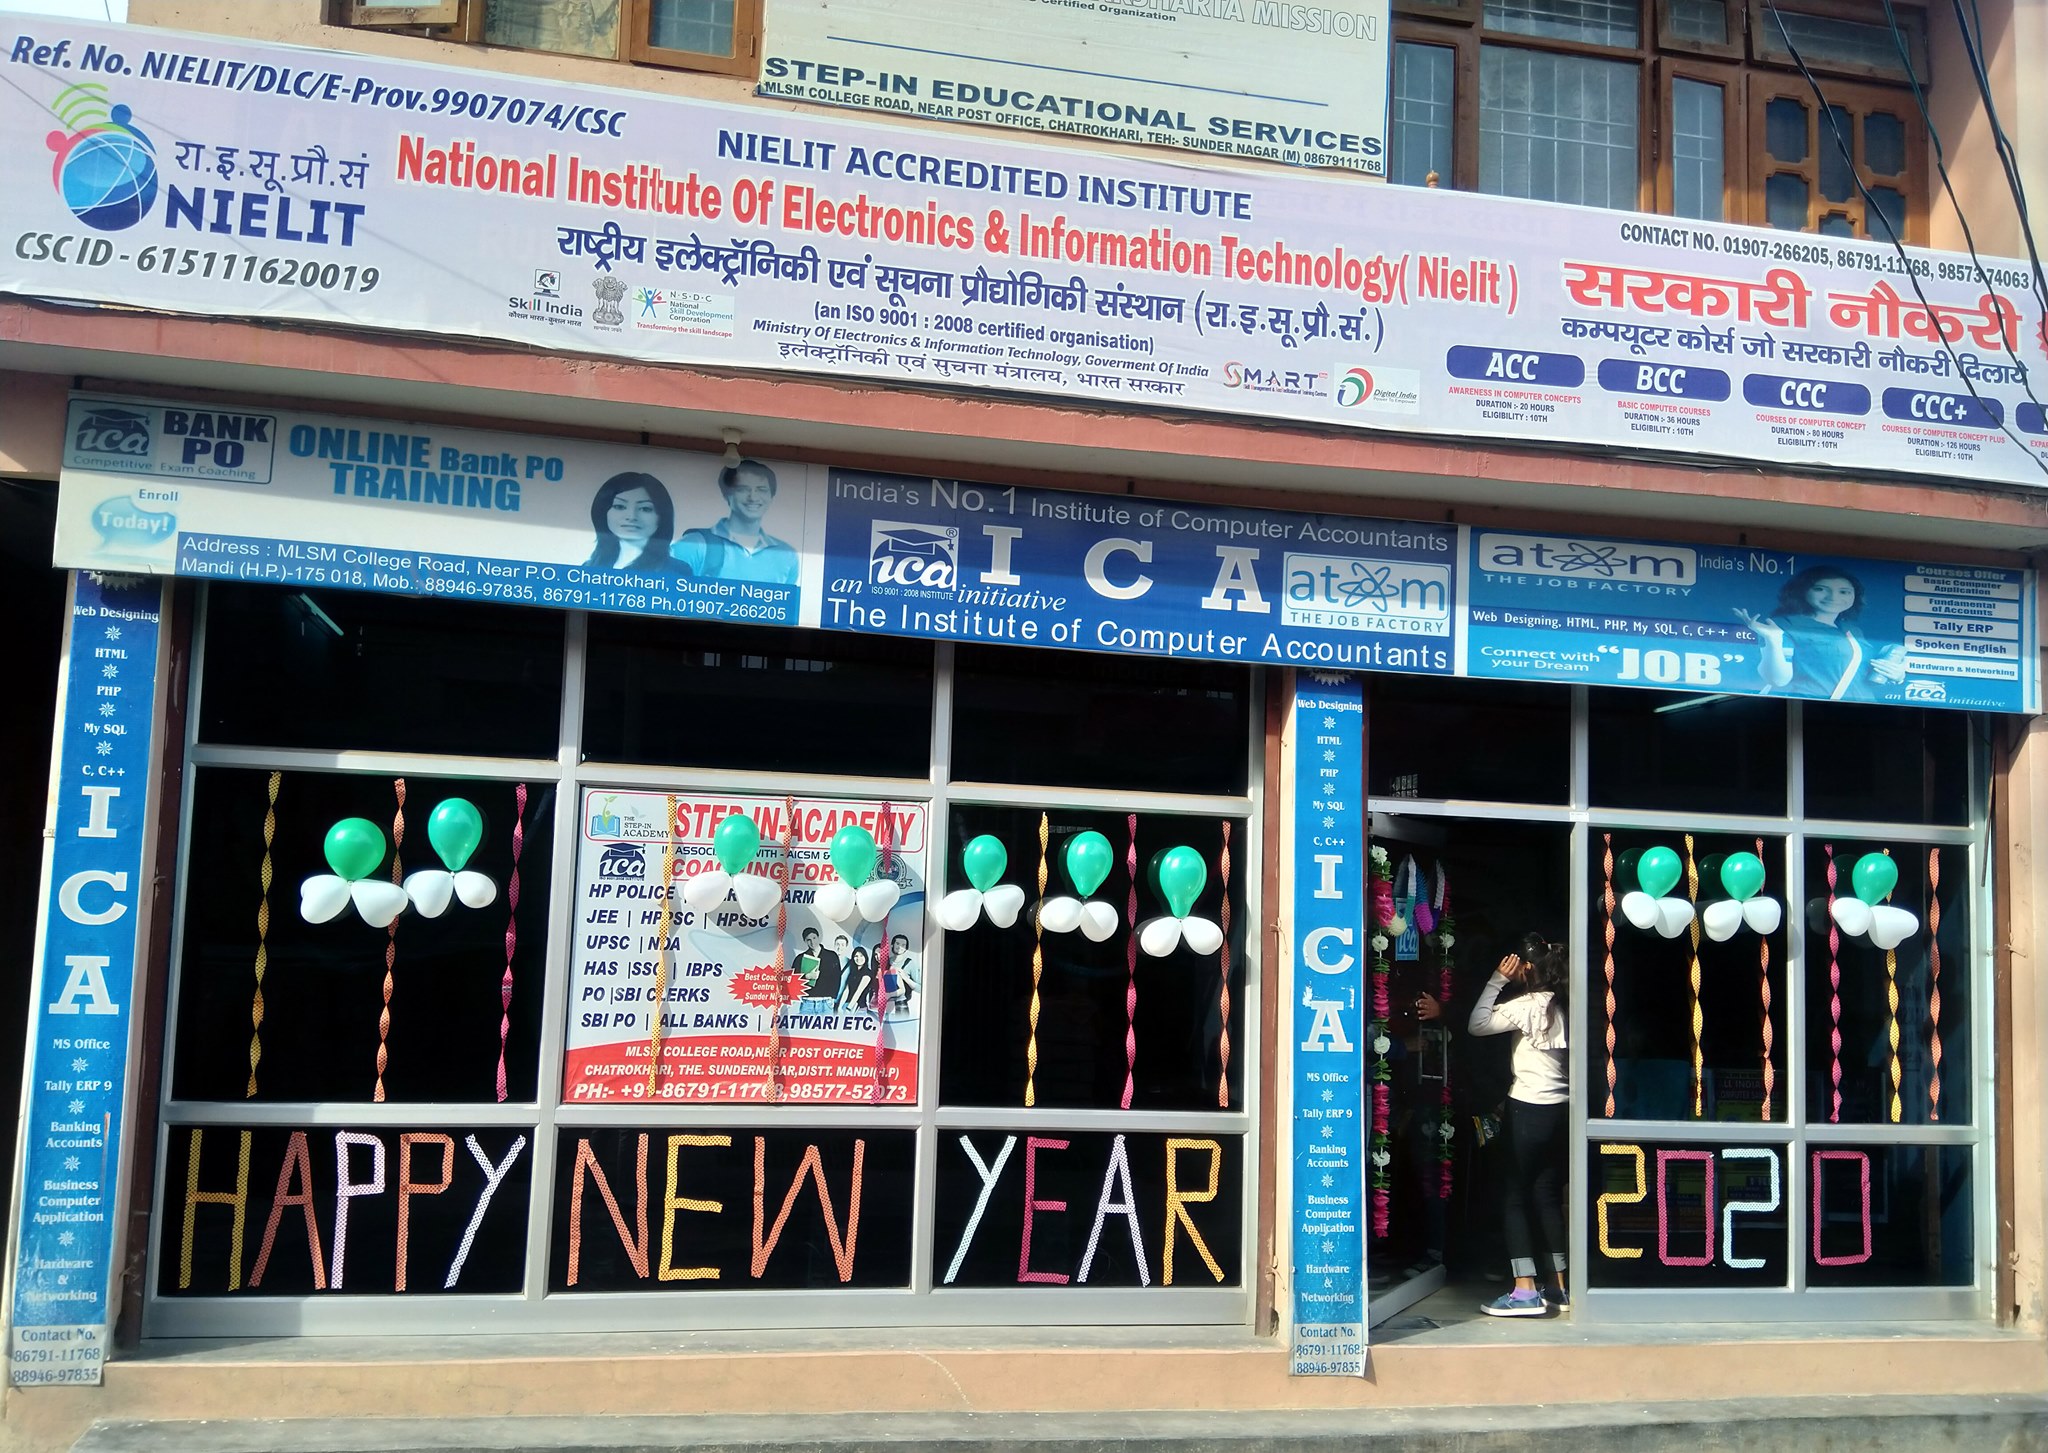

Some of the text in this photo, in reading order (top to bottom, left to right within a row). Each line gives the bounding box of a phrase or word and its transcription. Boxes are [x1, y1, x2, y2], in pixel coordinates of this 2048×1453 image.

[1252, 1, 1377, 41] MISSION
[10, 36, 627, 138] Ref. No. NIELIT/DLC/E-Prov.9907074/CSC
[765, 57, 1382, 156] STEP-IN EDUCATIONAL SERVICES
[765, 81, 1382, 172] MLSM COLLEGE ROAD, NEAR POST OFFICE, CHATROKHARI, TEH:- SUNDER NAGAR (M) 08679111768
[718, 130, 1252, 220] NIELIT ACCREDITED INSTITUTE
[165, 184, 366, 247] NIELIT
[397, 135, 557, 198] National
[568, 156, 722, 220] Institute
[733, 179, 774, 226] Of
[783, 185, 974, 250] Electronics
[984, 210, 1010, 254] &
[1020, 213, 1212, 276] Information
[1418, 256, 1500, 304] Nielit
[1621, 223, 1689, 248] CONTACT
[1693, 232, 1720, 252] NO.
[1724, 236, 1833, 269] 01907-266205,
[15, 232, 380, 293] CSC ID 615111620019
[557, 221, 647, 272] राष्ट्रीय
[656, 233, 820, 287] इलेक्ट्रॉनिकी
[828, 254, 873, 289] एवं
[875, 265, 953, 307] सूचना
[961, 266, 1088, 313] प्रौद्योगिकी
[1095, 282, 1185, 323] संस्थान
[509, 296, 583, 317] Skill India
[1564, 262, 2022, 353] सरकारी नौकरी
[814, 301, 1155, 356] (an ISO 9001 2008 certified organisation)
[753, 319, 1209, 378] Ministry Of Electronics & Information Technology, Goverment Of India
[1561, 318, 1671, 355] कम्पयूटर
[1677, 325, 1734, 354] कोर्स
[1742, 332, 1776, 358] जो
[1782, 340, 1873, 369] सरकारी
[1878, 345, 1951, 378] नौकरी
[1485, 352, 1539, 381] ACC
[1636, 365, 1686, 394] BCC
[1449, 386, 1582, 404] AWARENESS COMPUTER CONCEPTS
[1780, 381, 1827, 408] CCC
[1910, 393, 1968, 421] CCC+
[163, 410, 271, 443] BANK
[182, 438, 244, 468] PO
[289, 424, 564, 482] ONLINE Bank PO
[329, 462, 521, 512] TRAINING
[1031, 498, 1130, 526] Institute
[1139, 508, 1164, 528] of
[1171, 510, 1293, 539] Computer
[1298, 522, 1448, 551] Accountants
[183, 537, 791, 603] Address MLSM College Road, Near P.O. Chatrokhari, Sunder Nagar
[182, 557, 234, 575] Mandi
[239, 562, 325, 583] (H.P.)-175
[330, 570, 366, 587] 018,
[425, 577, 537, 602] 88946-97835,
[543, 587, 646, 609] 86791-11768
[651, 596, 786, 622] Ph.01907-266205
[73, 605, 160, 623] Web Designing
[1933, 620, 1994, 634] Tally ERP
[827, 597, 1447, 669] The Institute of Computer Accountants
[1915, 638, 2007, 655] Spoken English
[95, 648, 128, 660] HTML
[1480, 645, 1600, 663] Connect with
[1492, 657, 1589, 672] your Dream
[97, 685, 122, 697] PHP
[1317, 735, 1342, 746] HTML
[1320, 768, 1339, 777] PHP
[589, 884, 612, 899] HP
[586, 910, 619, 924] JEE
[716, 913, 770, 928] HPSSC
[586, 936, 630, 950] UPSC
[584, 962, 618, 976] HAS
[685, 963, 723, 978] IBPS
[692, 1014, 748, 1029] BANKS
[842, 1017, 877, 1032] ETC.
[74, 1038, 110, 1050] Office
[663, 1047, 864, 1060] COLLEGE POST OFFICE
[1306, 1158, 1349, 1169] Accounts
[1309, 1144, 1347, 1157] Banking
[178, 1128, 1872, 1291] HAPPY NEW YEAR 2020
[1308, 1195, 1349, 1205] Business
[1305, 1208, 1351, 1221] Computer
[1296, 1362, 1360, 1375] 88946-97835
